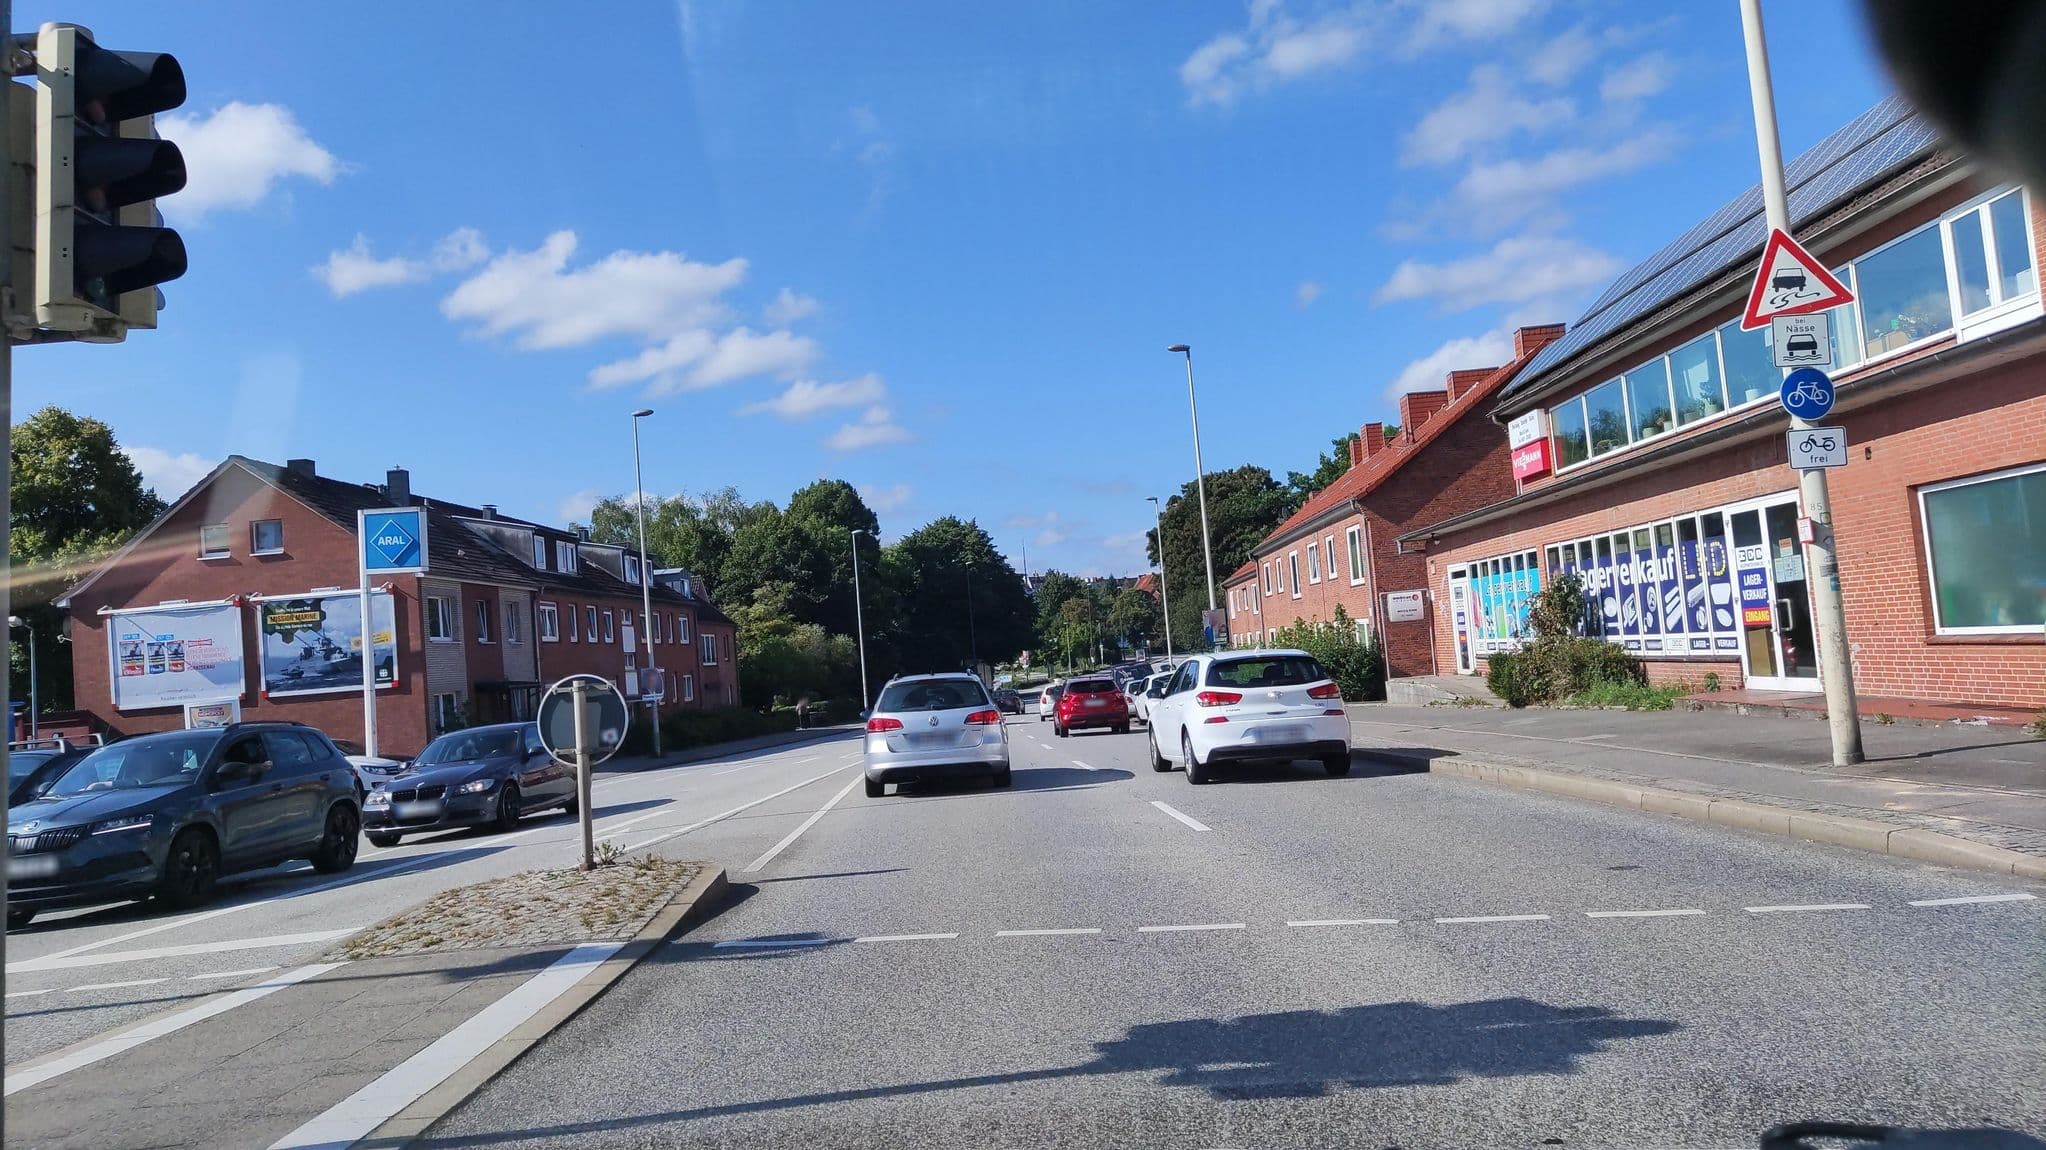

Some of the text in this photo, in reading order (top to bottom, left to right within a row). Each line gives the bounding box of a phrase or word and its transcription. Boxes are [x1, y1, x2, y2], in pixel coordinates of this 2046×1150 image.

[1786, 324, 1815, 333] Nässe
[1810, 454, 1828, 463] frei
[377, 535, 406, 546] ARAL
[1682, 541, 1726, 580] LED
[1743, 573, 1763, 586] LAGER-
[1742, 588, 1768, 600] VERKAUF
[269, 612, 317, 623] MISSION MARINE
[1745, 610, 1770, 622] EINGANG
